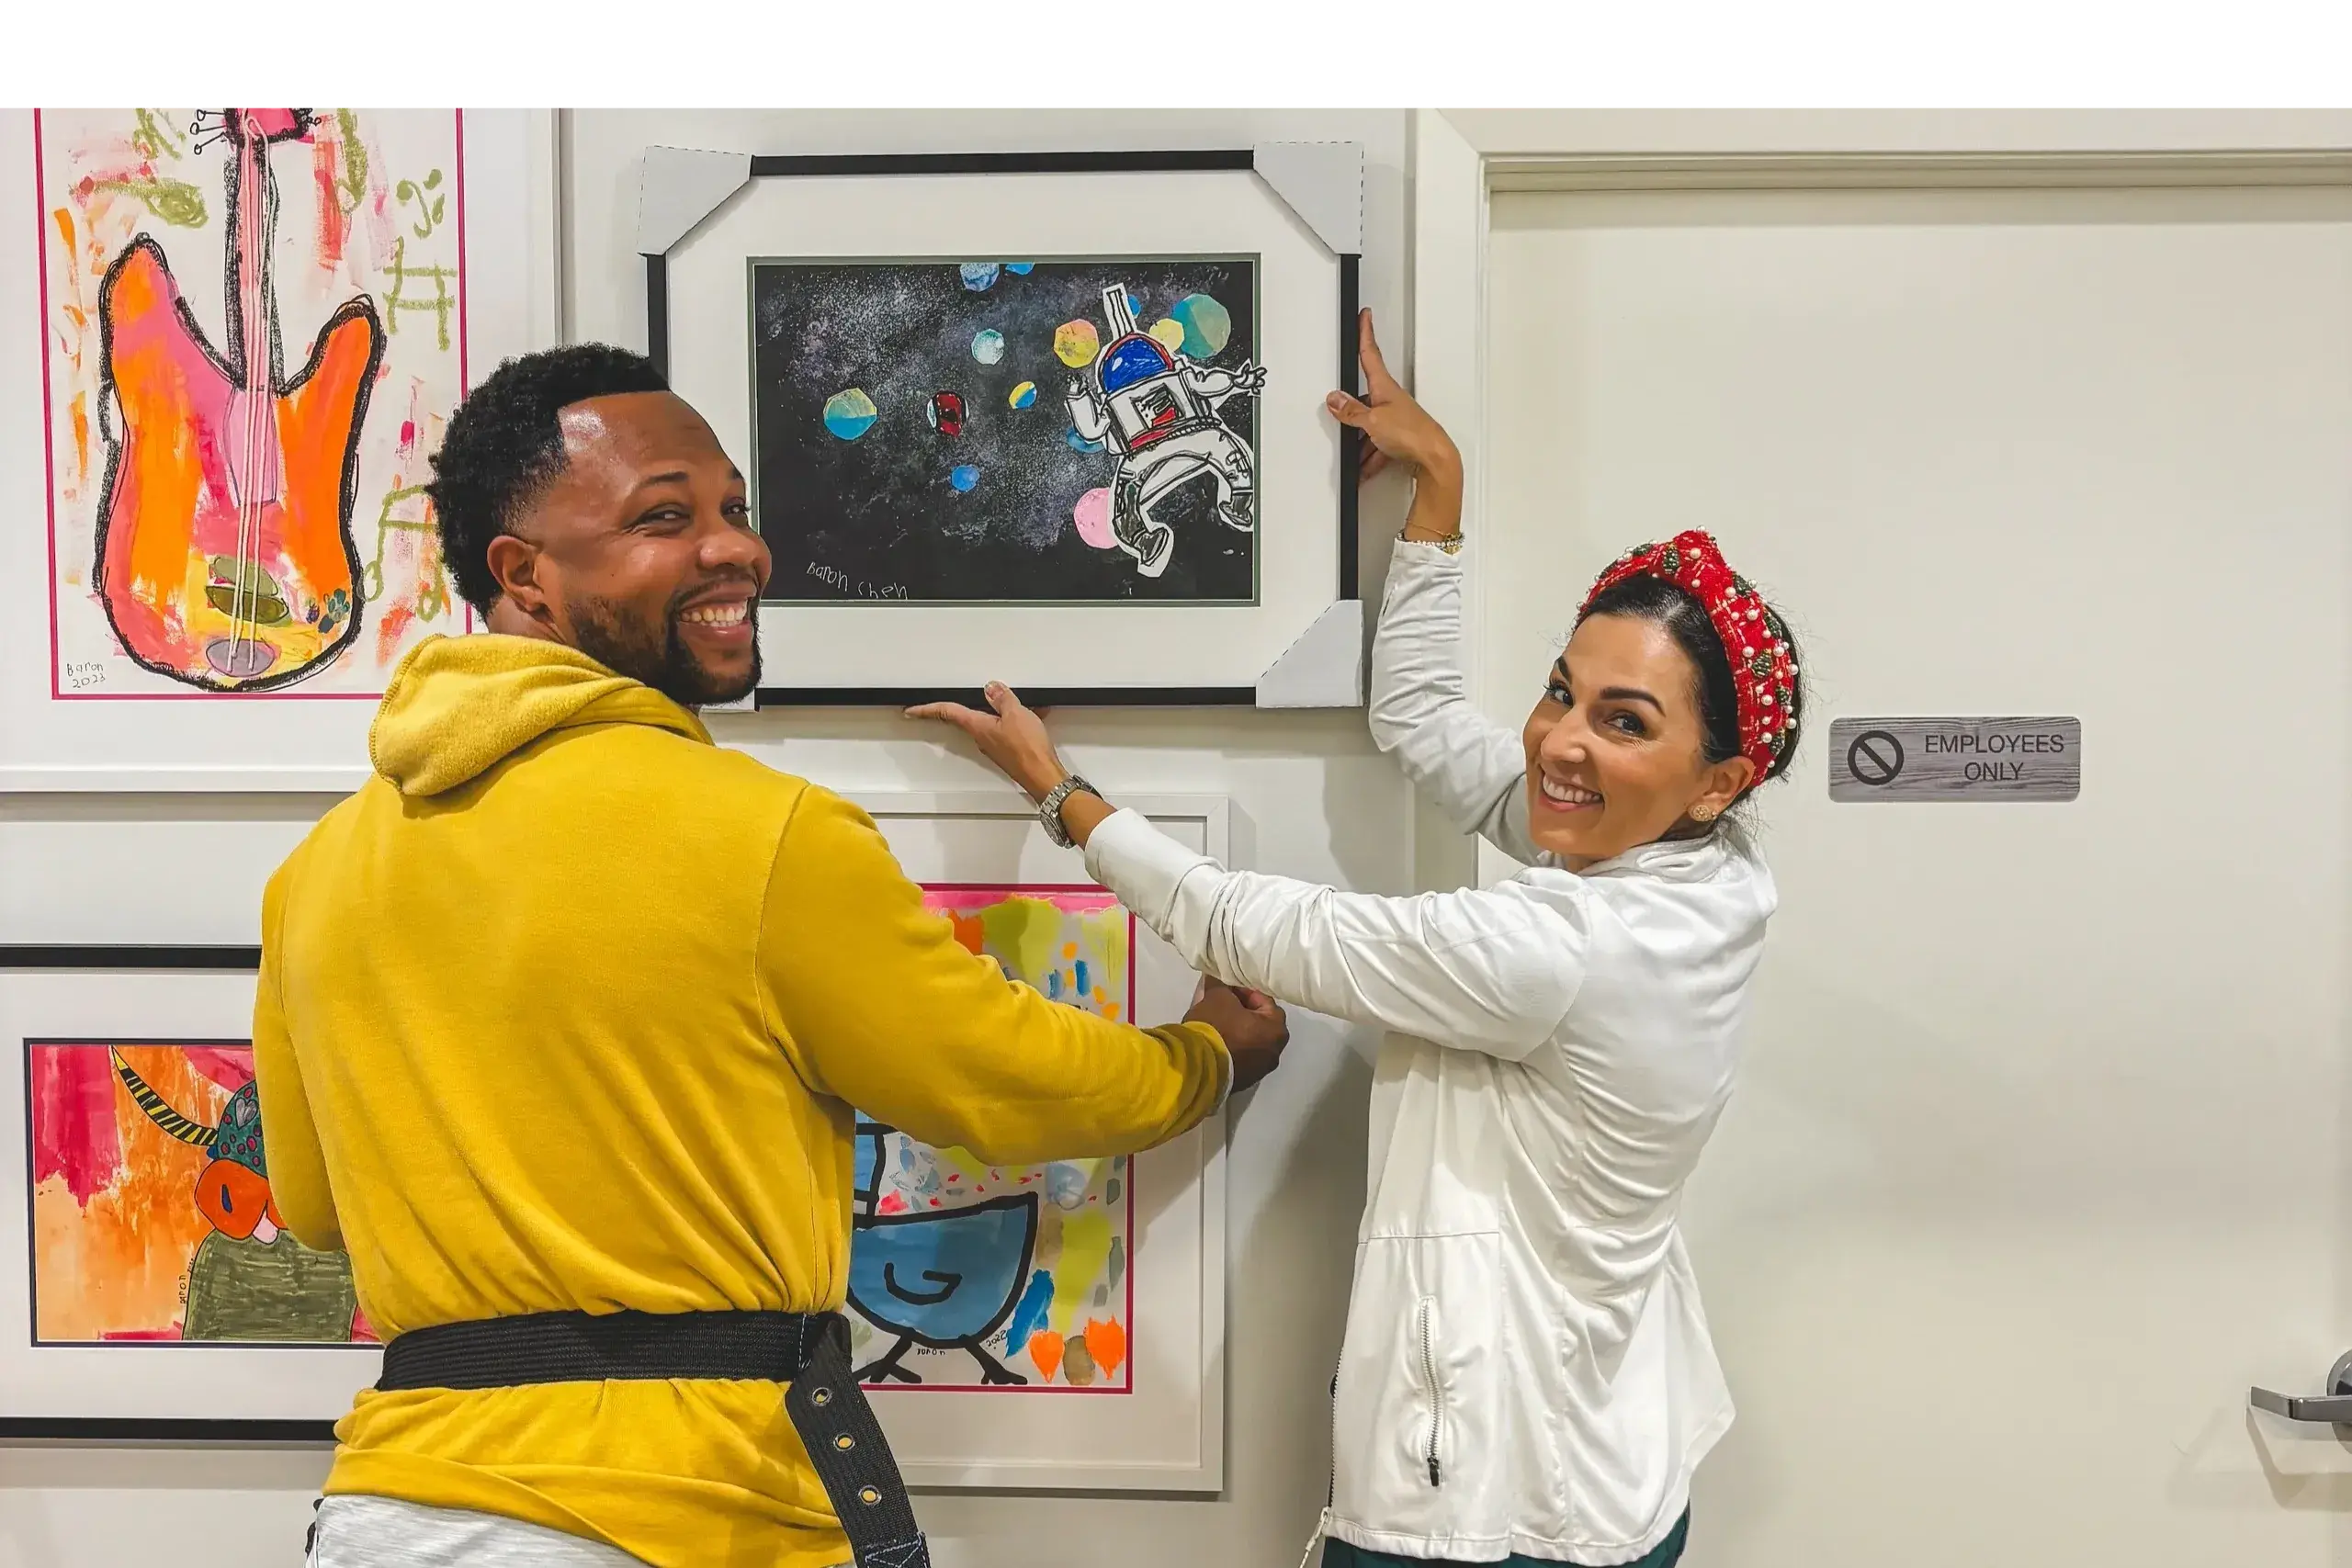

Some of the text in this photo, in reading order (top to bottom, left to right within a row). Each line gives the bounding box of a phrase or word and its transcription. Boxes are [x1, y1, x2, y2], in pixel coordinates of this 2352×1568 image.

[807, 561, 848, 592] Baron
[66, 661, 104, 677] Baron
[72, 672, 106, 689] 2023
[1925, 734, 2064, 754] EMPLOYEES
[1964, 761, 2024, 782] ONLY
